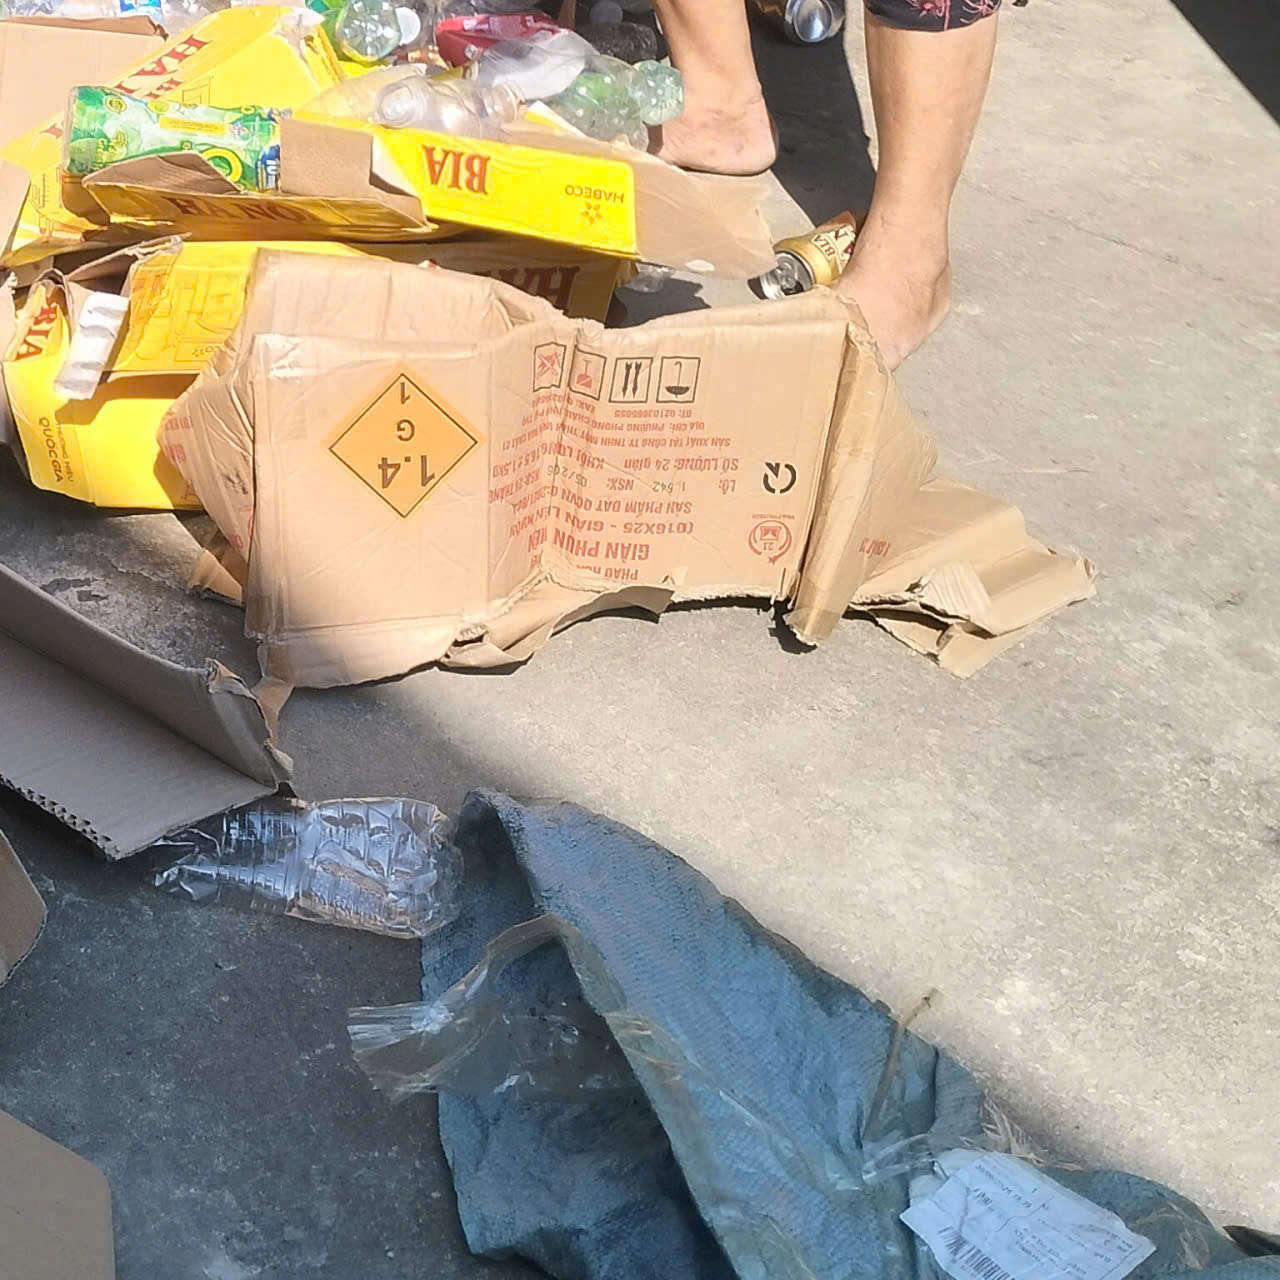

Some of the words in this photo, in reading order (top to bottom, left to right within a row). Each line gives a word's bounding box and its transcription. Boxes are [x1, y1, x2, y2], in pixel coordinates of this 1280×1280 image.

[422, 144, 491, 195] BIA
[565, 184, 624, 204] HABECO
[400, 382, 411, 405] 1
[396, 419, 416, 442] G
[377, 455, 436, 489] 1.4
